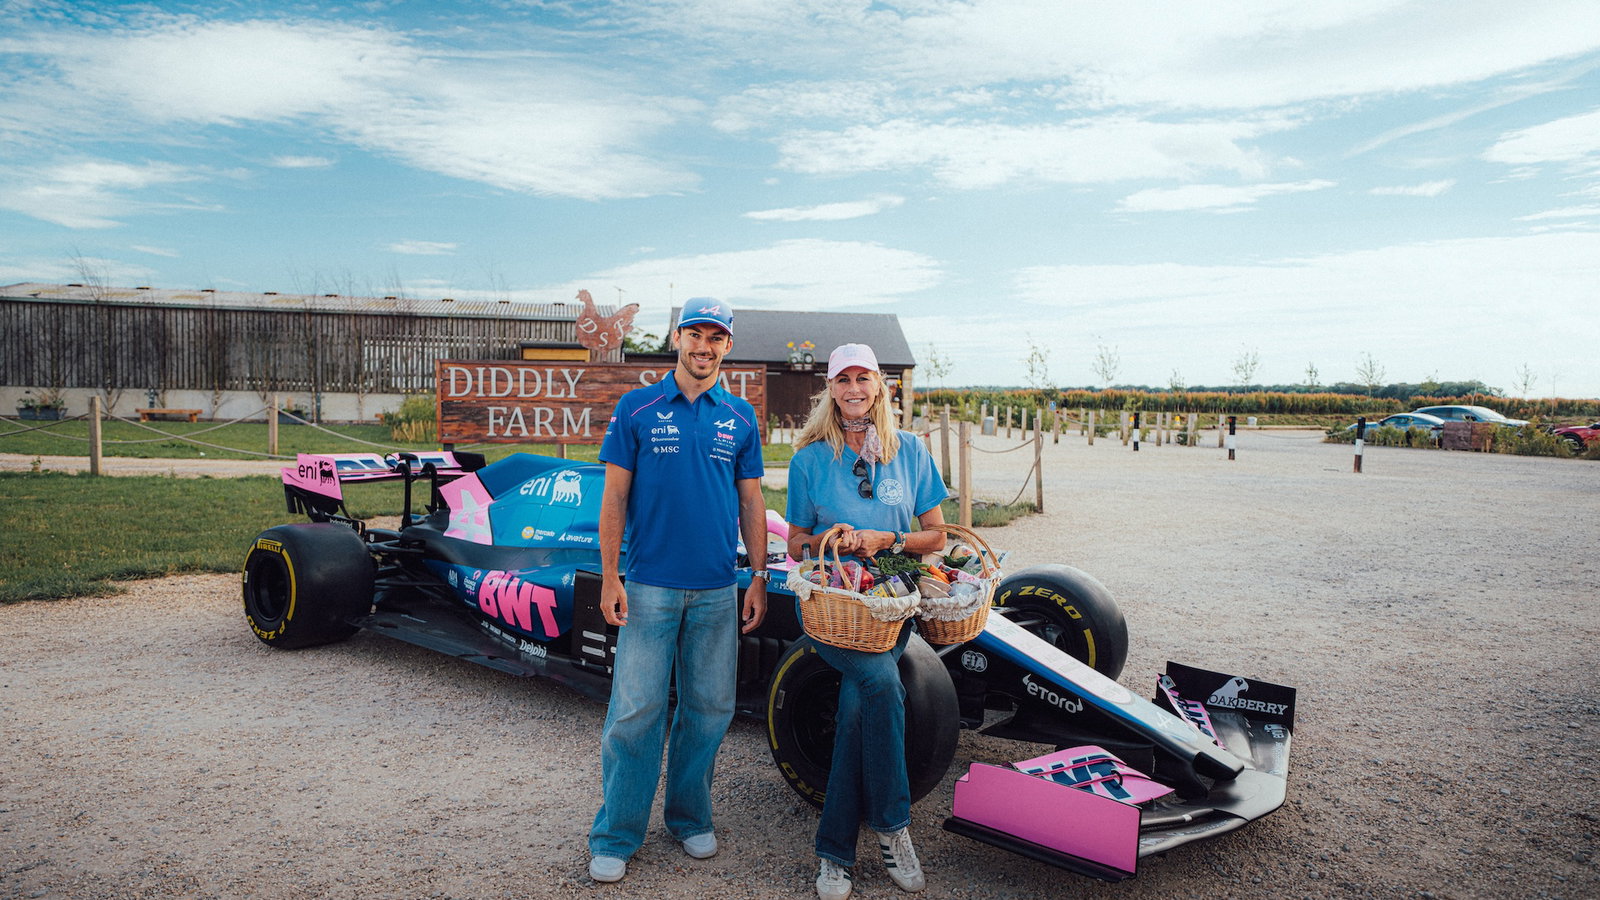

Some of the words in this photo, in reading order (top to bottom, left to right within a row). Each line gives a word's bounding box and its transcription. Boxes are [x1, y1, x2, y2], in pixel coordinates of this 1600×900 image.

[448, 366, 586, 398] DIDDLY
[639, 369, 756, 401] SAT
[486, 406, 592, 437] FARM
[651, 425, 666, 434] eni
[660, 445, 680, 453] MSC
[298, 463, 318, 480] eni
[519, 472, 558, 497] eni
[257, 538, 283, 554] PIRELLI
[478, 570, 561, 638] BWT
[1018, 585, 1083, 620] ZERO
[519, 639, 547, 659] Delphi
[962, 652, 986, 670] FIA
[1208, 694, 1288, 716] OAKBERRY
